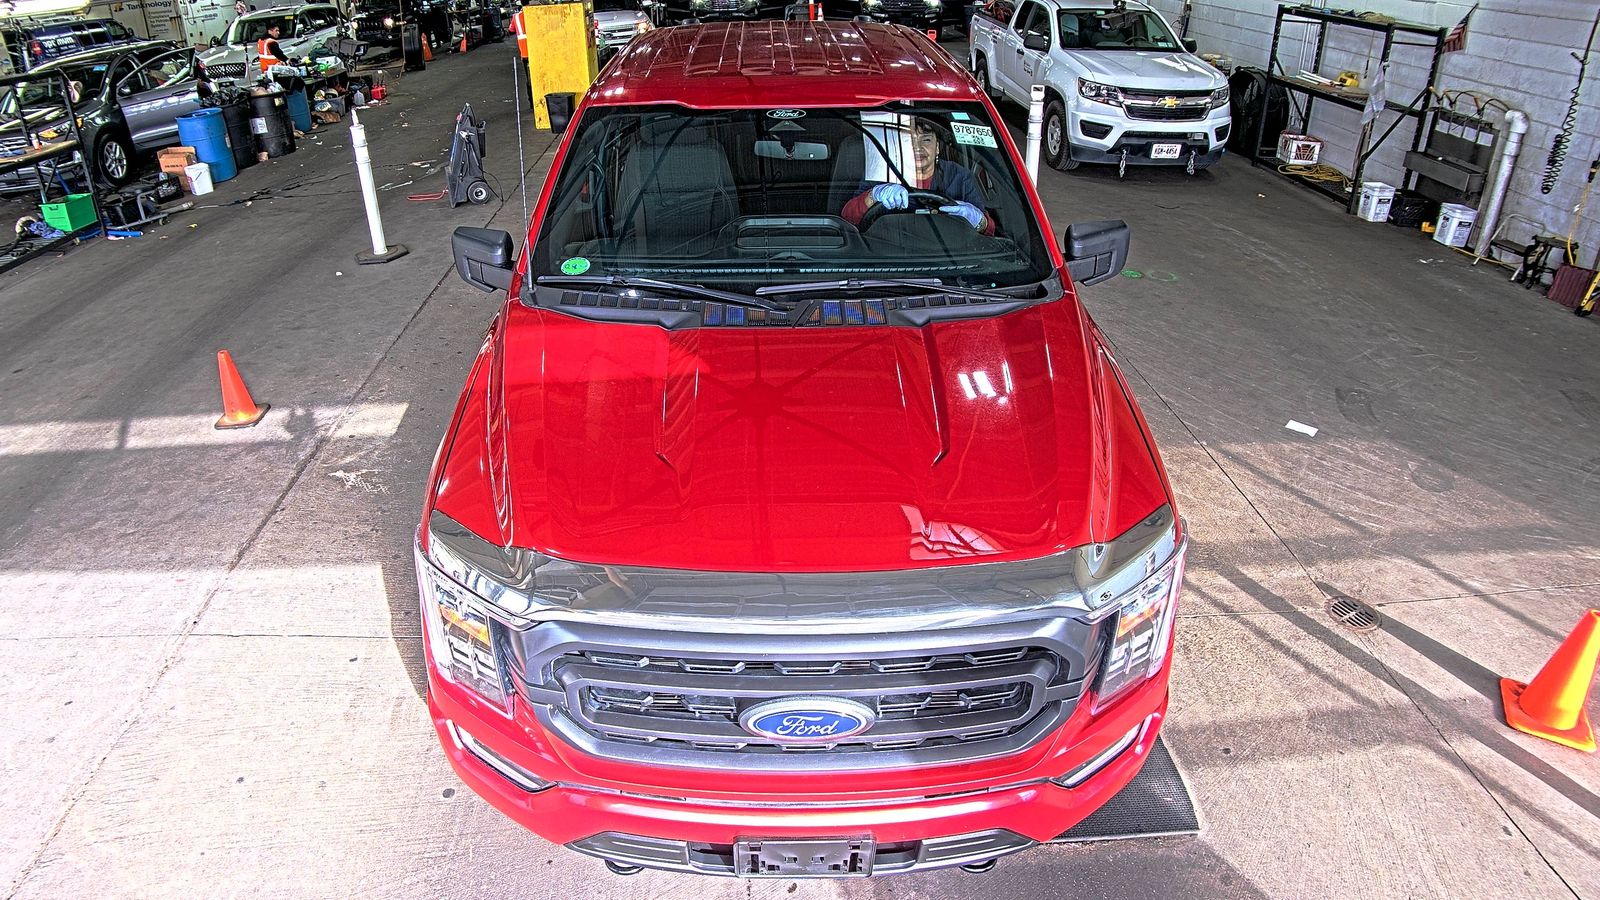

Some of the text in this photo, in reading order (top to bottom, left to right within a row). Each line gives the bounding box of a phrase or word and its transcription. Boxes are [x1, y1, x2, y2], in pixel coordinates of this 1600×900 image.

[42, 36, 75, 48] optmum
[953, 124, 994, 137] 9787650
[776, 715, 840, 735] Ford
